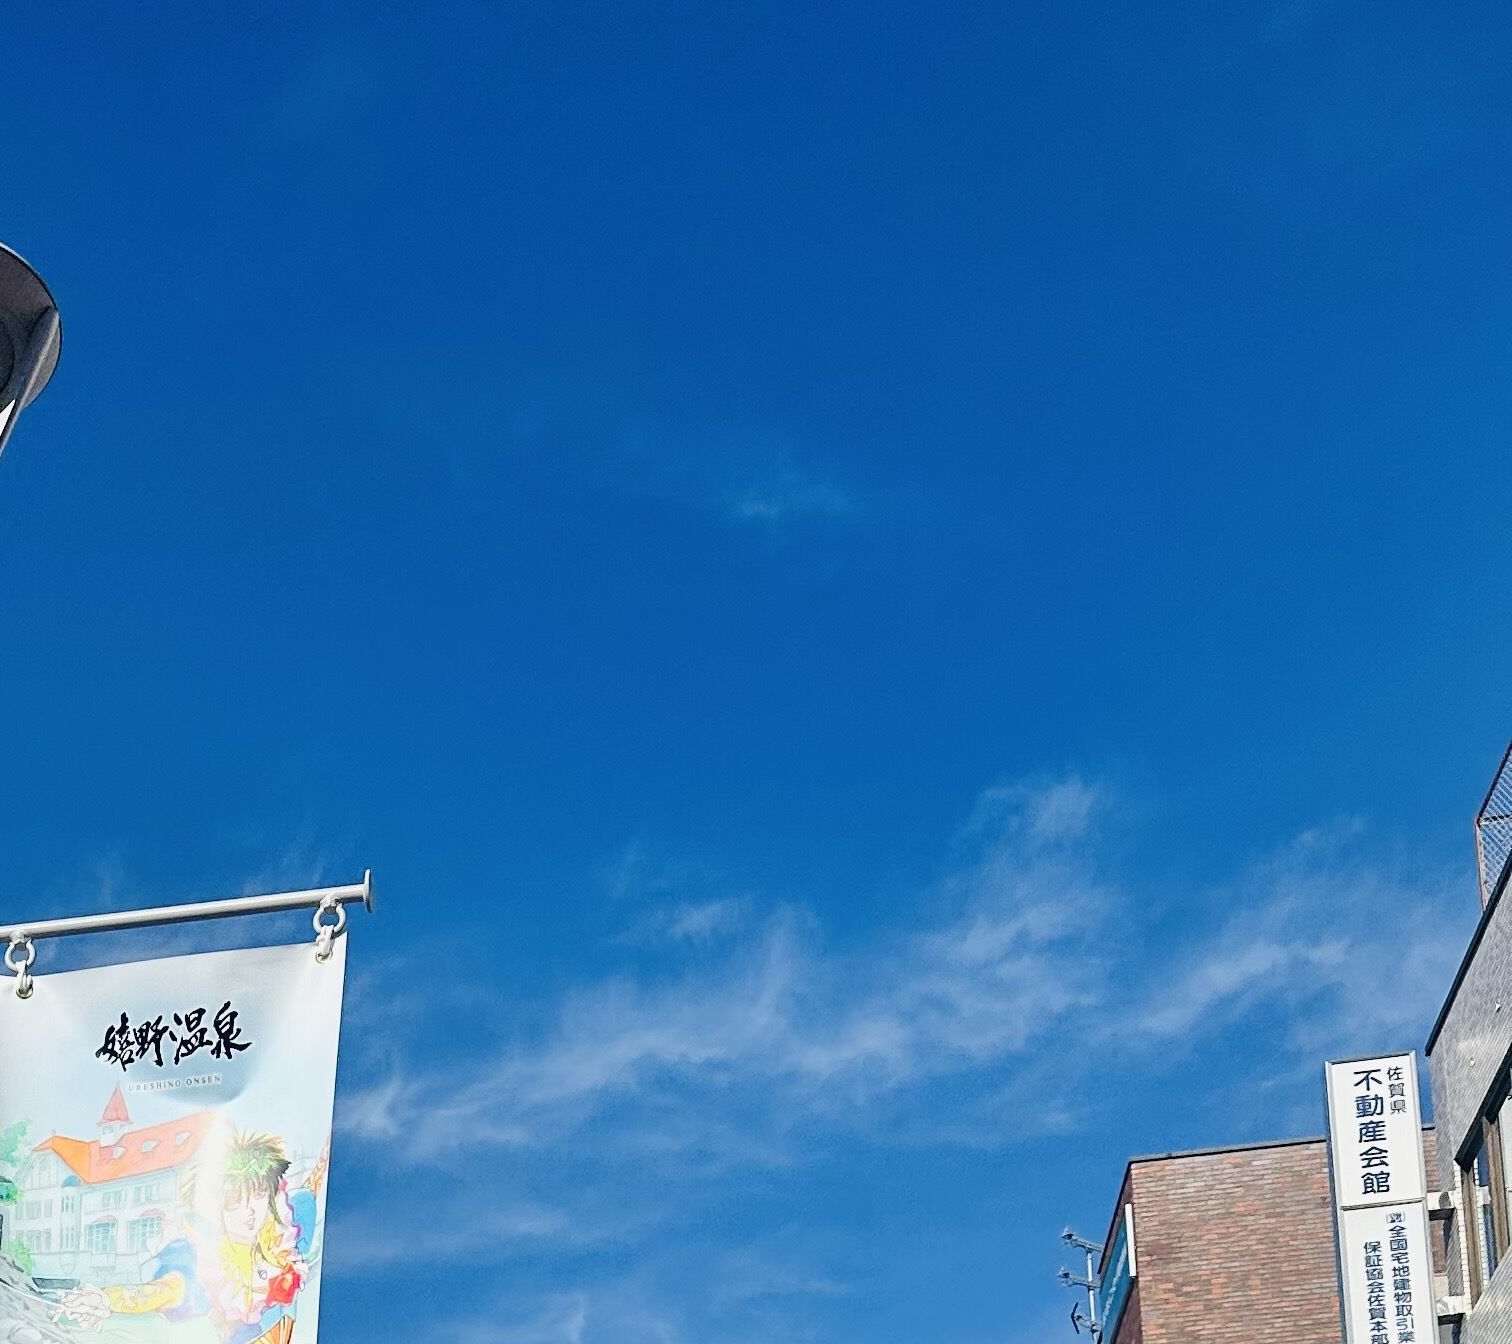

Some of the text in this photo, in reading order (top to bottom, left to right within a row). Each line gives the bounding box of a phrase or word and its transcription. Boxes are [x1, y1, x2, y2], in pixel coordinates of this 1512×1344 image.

[186, 1074, 221, 1086] ONSEN
[1387, 1066, 1407, 1114] 佐賀県
[1353, 1068, 1391, 1195] 不動産会館
